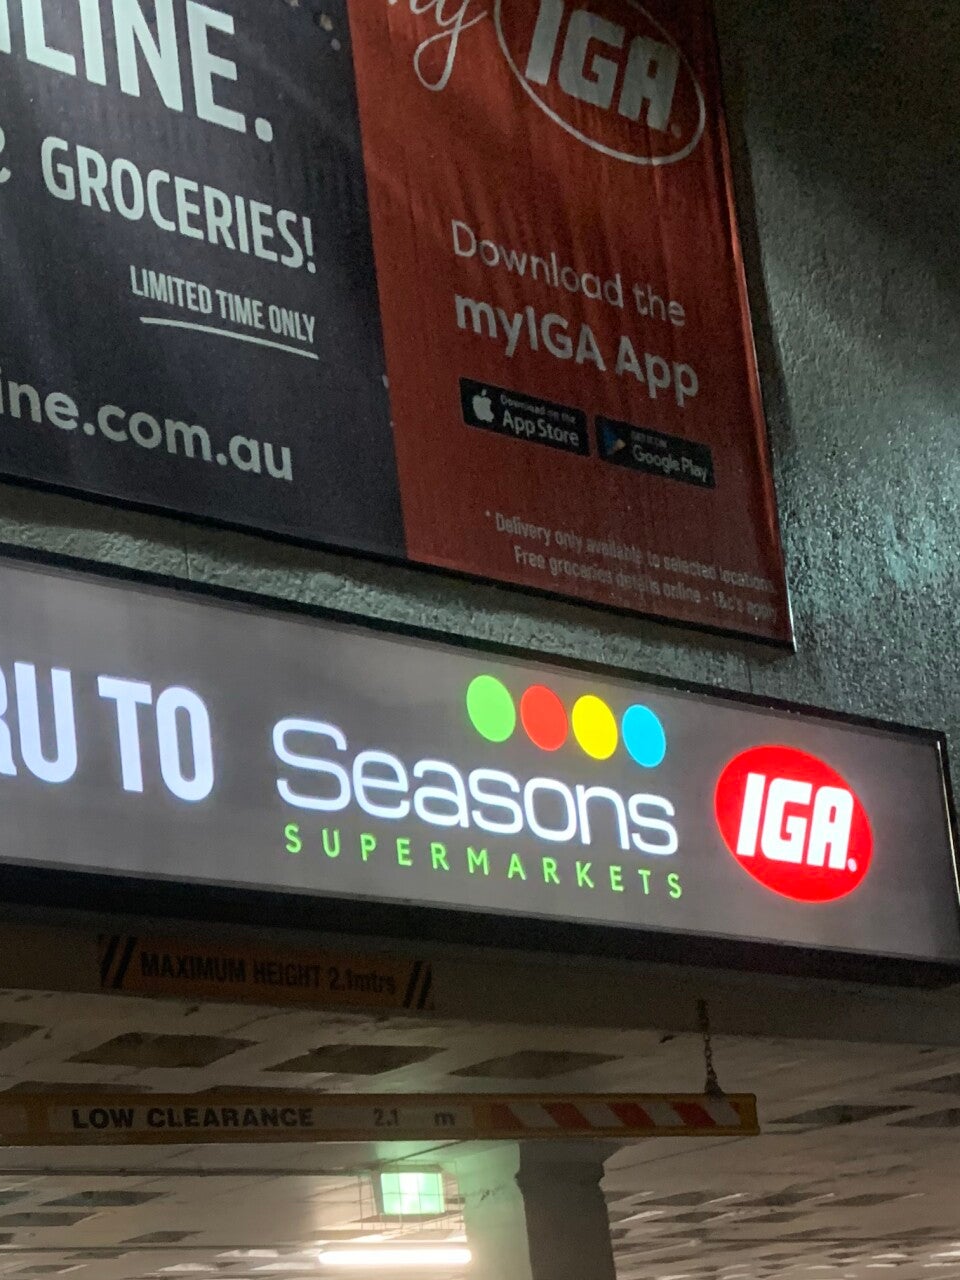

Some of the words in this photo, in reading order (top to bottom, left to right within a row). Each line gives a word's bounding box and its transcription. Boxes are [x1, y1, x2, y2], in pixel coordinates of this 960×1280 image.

[42, 136, 316, 274] GROCERIES!
[130, 265, 212, 314] LIMITED
[216, 289, 263, 330] TIME
[268, 305, 315, 343] ONLY
[452, 220, 623, 308] Download
[632, 283, 685, 326] the
[455, 294, 606, 371] myIGA
[615, 335, 699, 408] App
[502, 410, 535, 437] App
[538, 419, 580, 446] Store
[632, 444, 680, 474] Google
[681, 457, 708, 482] Play
[496, 513, 551, 546] Delivery
[555, 532, 583, 555] only
[647, 550, 660, 568] to
[514, 545, 545, 569] Free
[97, 675, 215, 801] TO
[272, 717, 679, 856] Seasons
[284, 824, 683, 898] SUPERMARKETS
[140, 952, 245, 983] MAXIMUM
[253, 961, 320, 987] HEIGHT
[72, 1107, 134, 1129] LOW
[146, 1107, 314, 1128] CLEARANCE
[373, 1107, 399, 1127] 2.1
